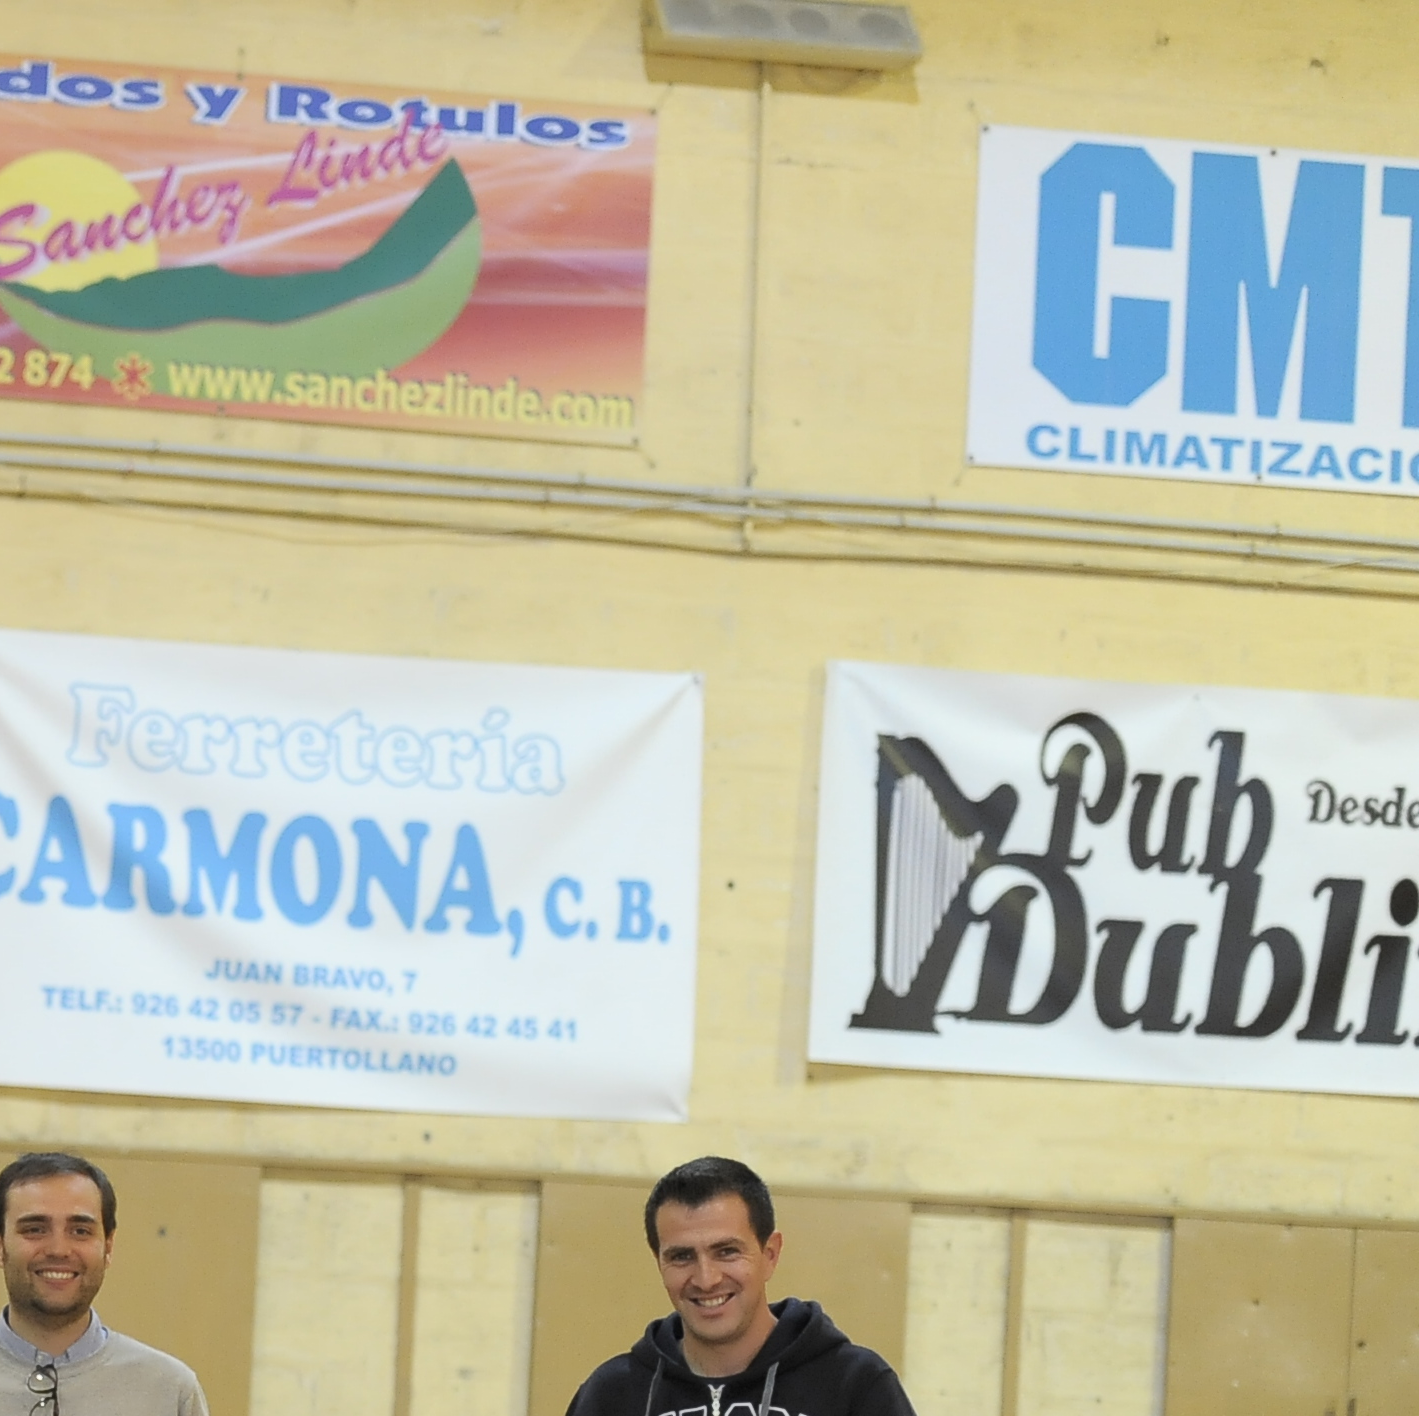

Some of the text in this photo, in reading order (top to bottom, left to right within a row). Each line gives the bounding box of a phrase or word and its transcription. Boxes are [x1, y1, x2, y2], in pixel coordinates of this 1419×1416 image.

[185, 75, 245, 122] y
[266, 82, 631, 150] Rotulos
[266, 108, 452, 208] Linde
[22, 350, 95, 390] 874
[167, 358, 637, 431] www.sanchezlinde.com
[1025, 424, 1419, 485] CLIMATIZACI
[66, 682, 566, 796] Ferretería
[1040, 711, 1275, 878] Pub
[543, 876, 599, 942] C.
[615, 880, 671, 944] B.
[204, 957, 418, 995] JUAN BRAVO, 7
[938, 852, 1419, 1047] Dubli
[42, 986, 124, 1014] TELF.:
[131, 991, 181, 1018] 926
[189, 996, 222, 1021] 42
[229, 999, 264, 1024] 05
[270, 1001, 305, 1027] 57
[329, 1004, 401, 1035] FAX.:
[408, 1010, 456, 1037] 926
[464, 1014, 499, 1039] 42
[505, 1016, 541, 1041] 45
[547, 1018, 579, 1042] 41
[161, 1036, 459, 1077] 13500 PUERTOLLANO
